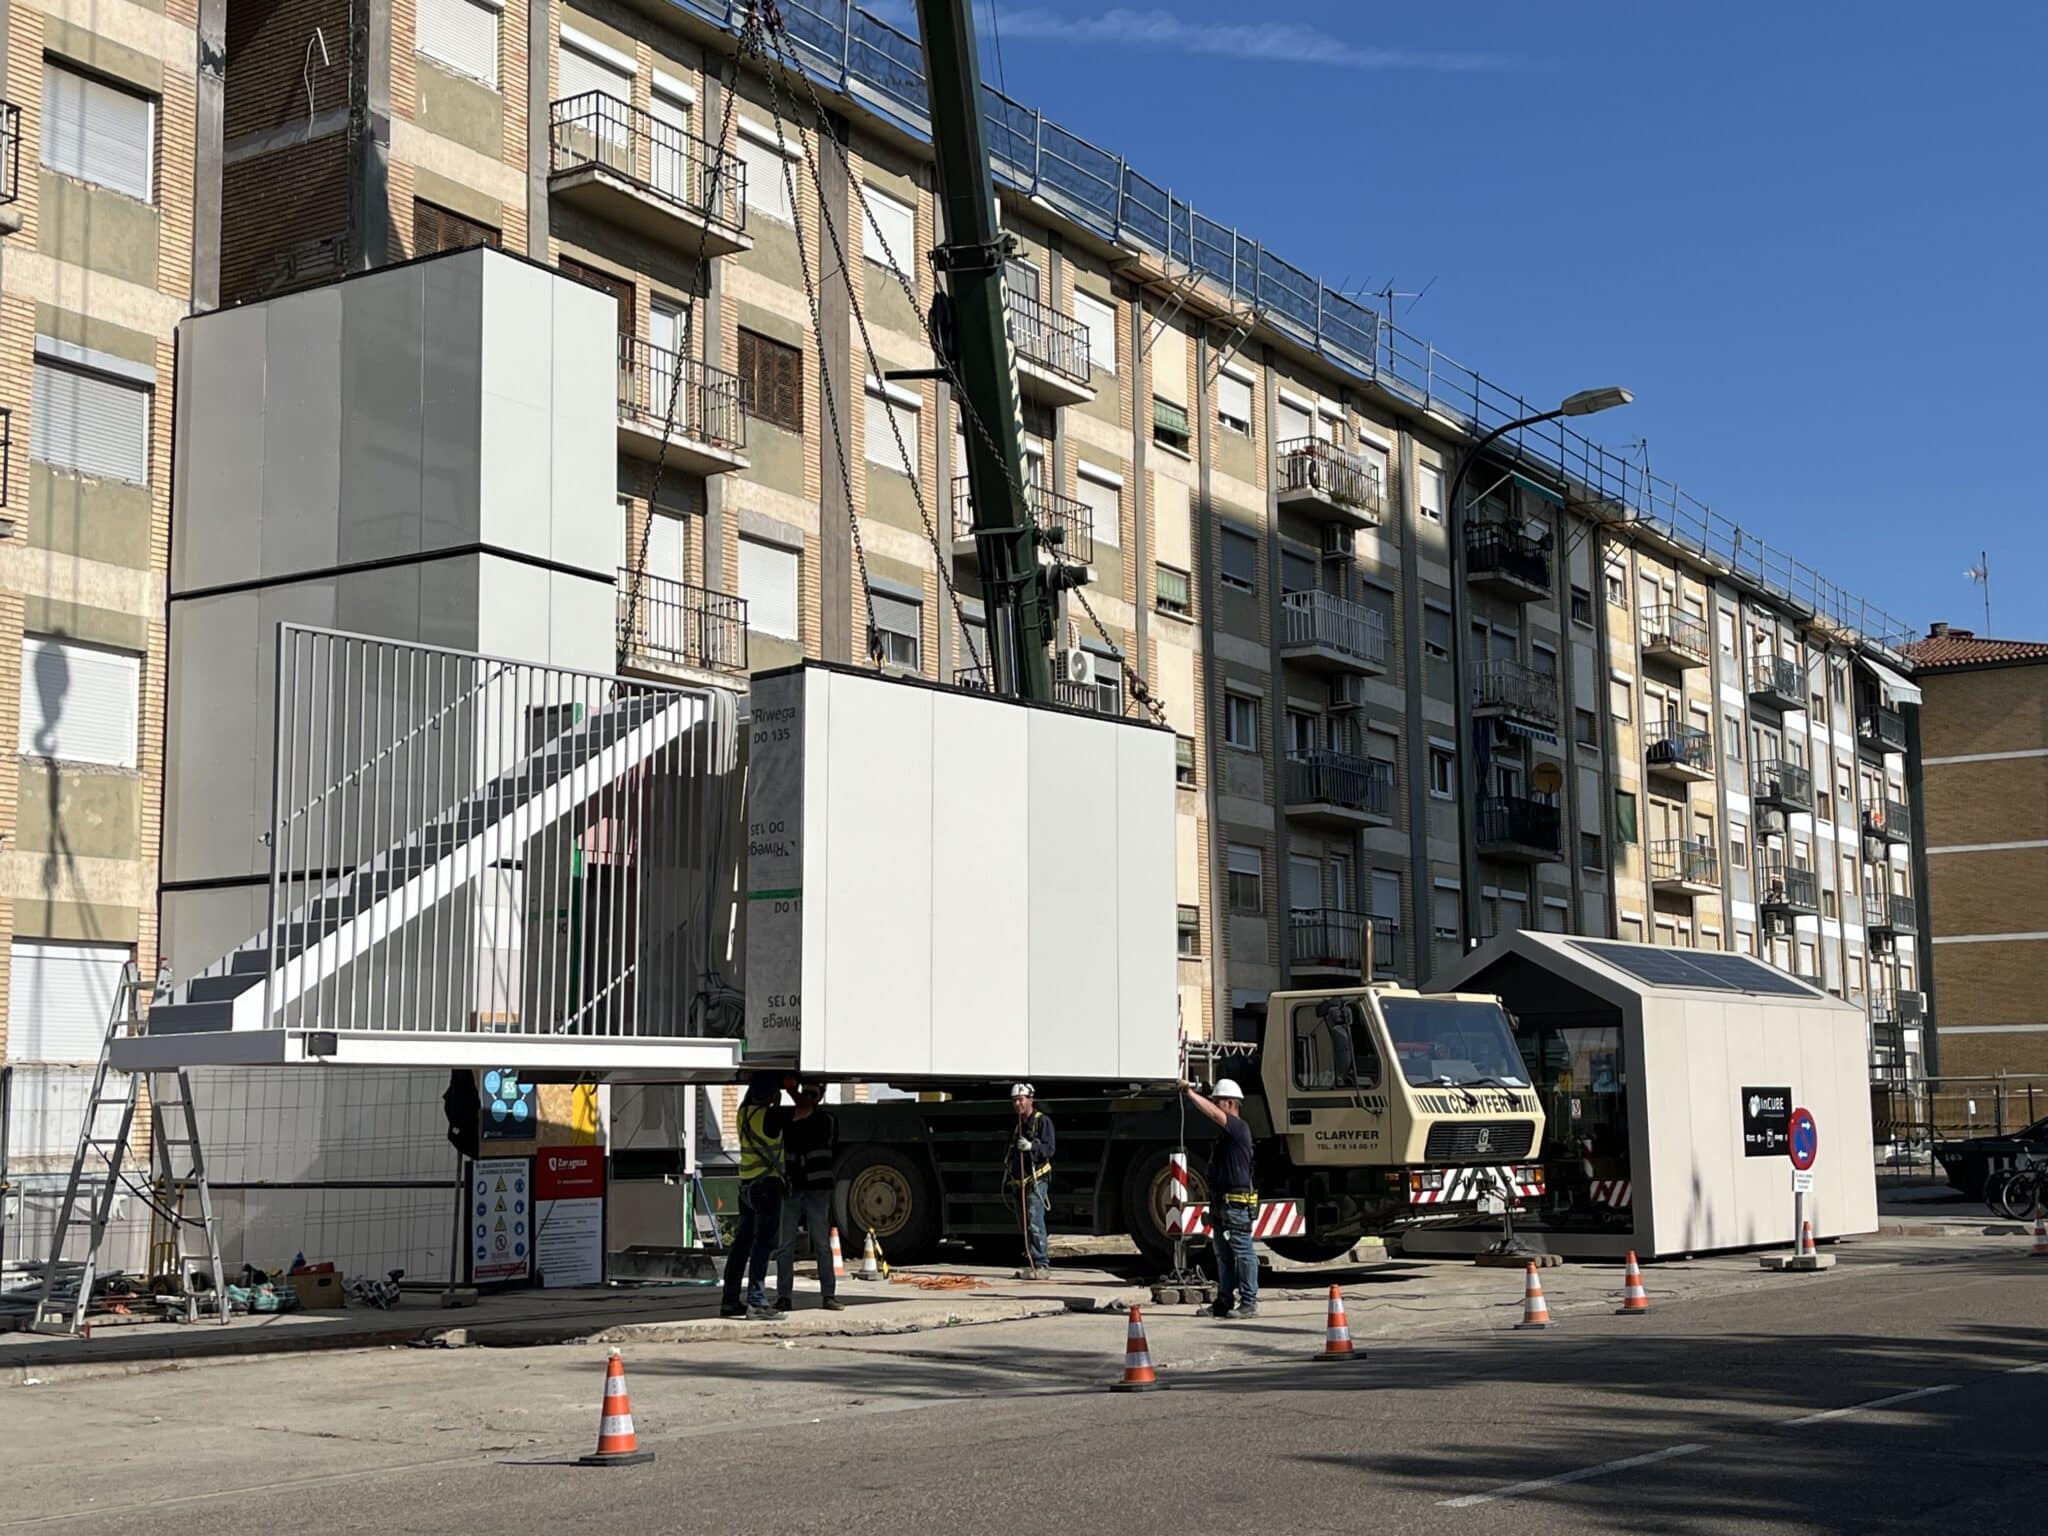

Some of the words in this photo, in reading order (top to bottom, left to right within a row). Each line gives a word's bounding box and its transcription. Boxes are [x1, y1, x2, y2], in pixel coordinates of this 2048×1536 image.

[755, 706, 796, 723] Riwega
[772, 728, 790, 741] 135
[768, 995, 786, 1007] 135
[1315, 1130, 1379, 1140] CLARYFER
